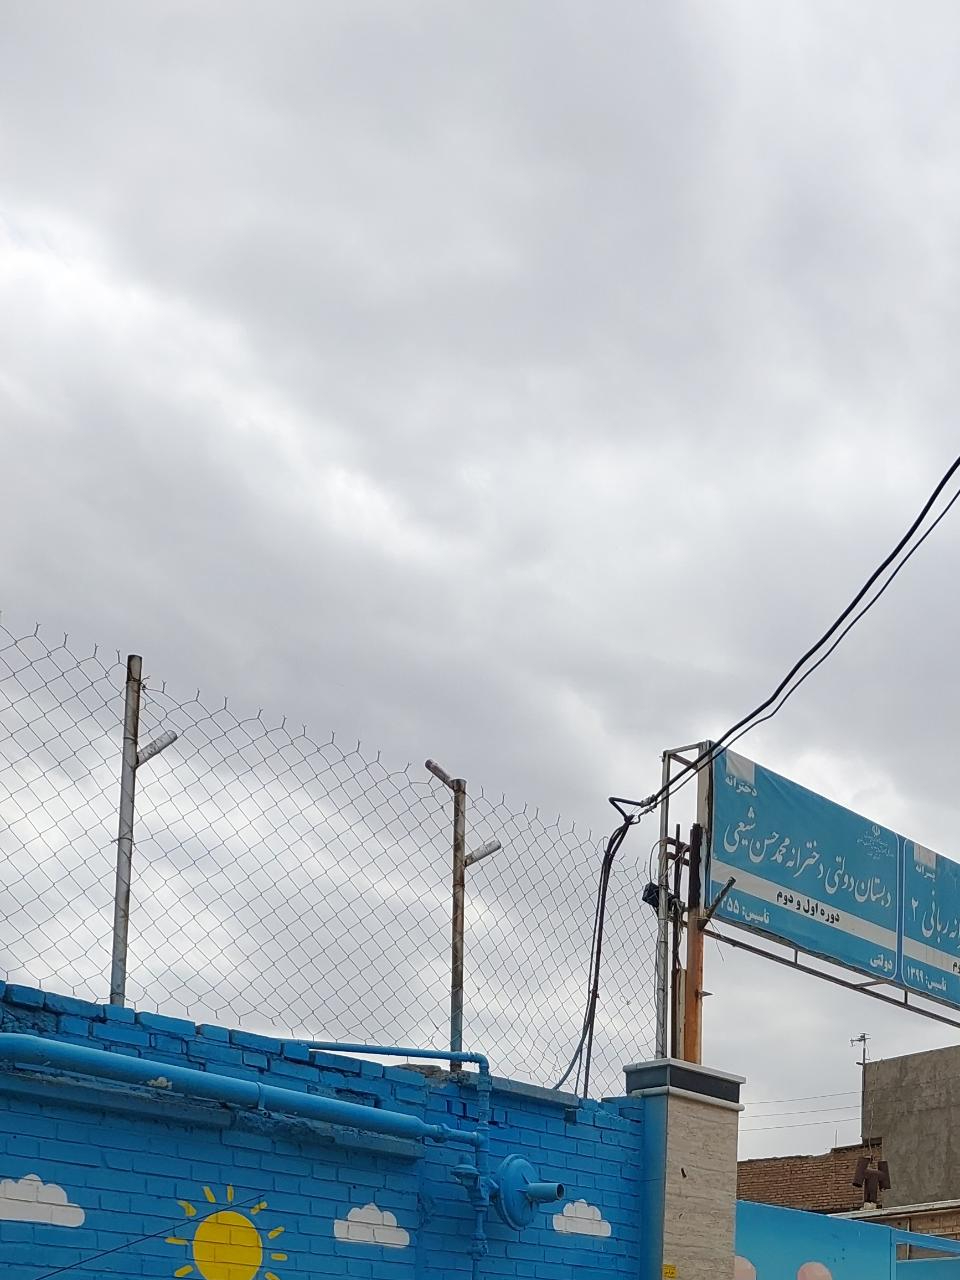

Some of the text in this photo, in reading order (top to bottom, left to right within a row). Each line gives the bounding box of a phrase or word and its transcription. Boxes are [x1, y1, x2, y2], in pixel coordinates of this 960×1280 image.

[725, 776, 758, 798] دخترانه
[748, 831, 780, 863] حسن
[770, 836, 791, 864] محمد
[785, 840, 825, 880] دخترانه
[825, 855, 855, 894] دولتی
[915, 863, 936, 882] پسرانه
[855, 875, 892, 908] دبستان
[776, 891, 840, 926] دوره اول و دوم
[911, 896, 919, 921] ۲
[869, 953, 893, 973] دولتی
[907, 964, 924, 984] ۱۳۹۹
